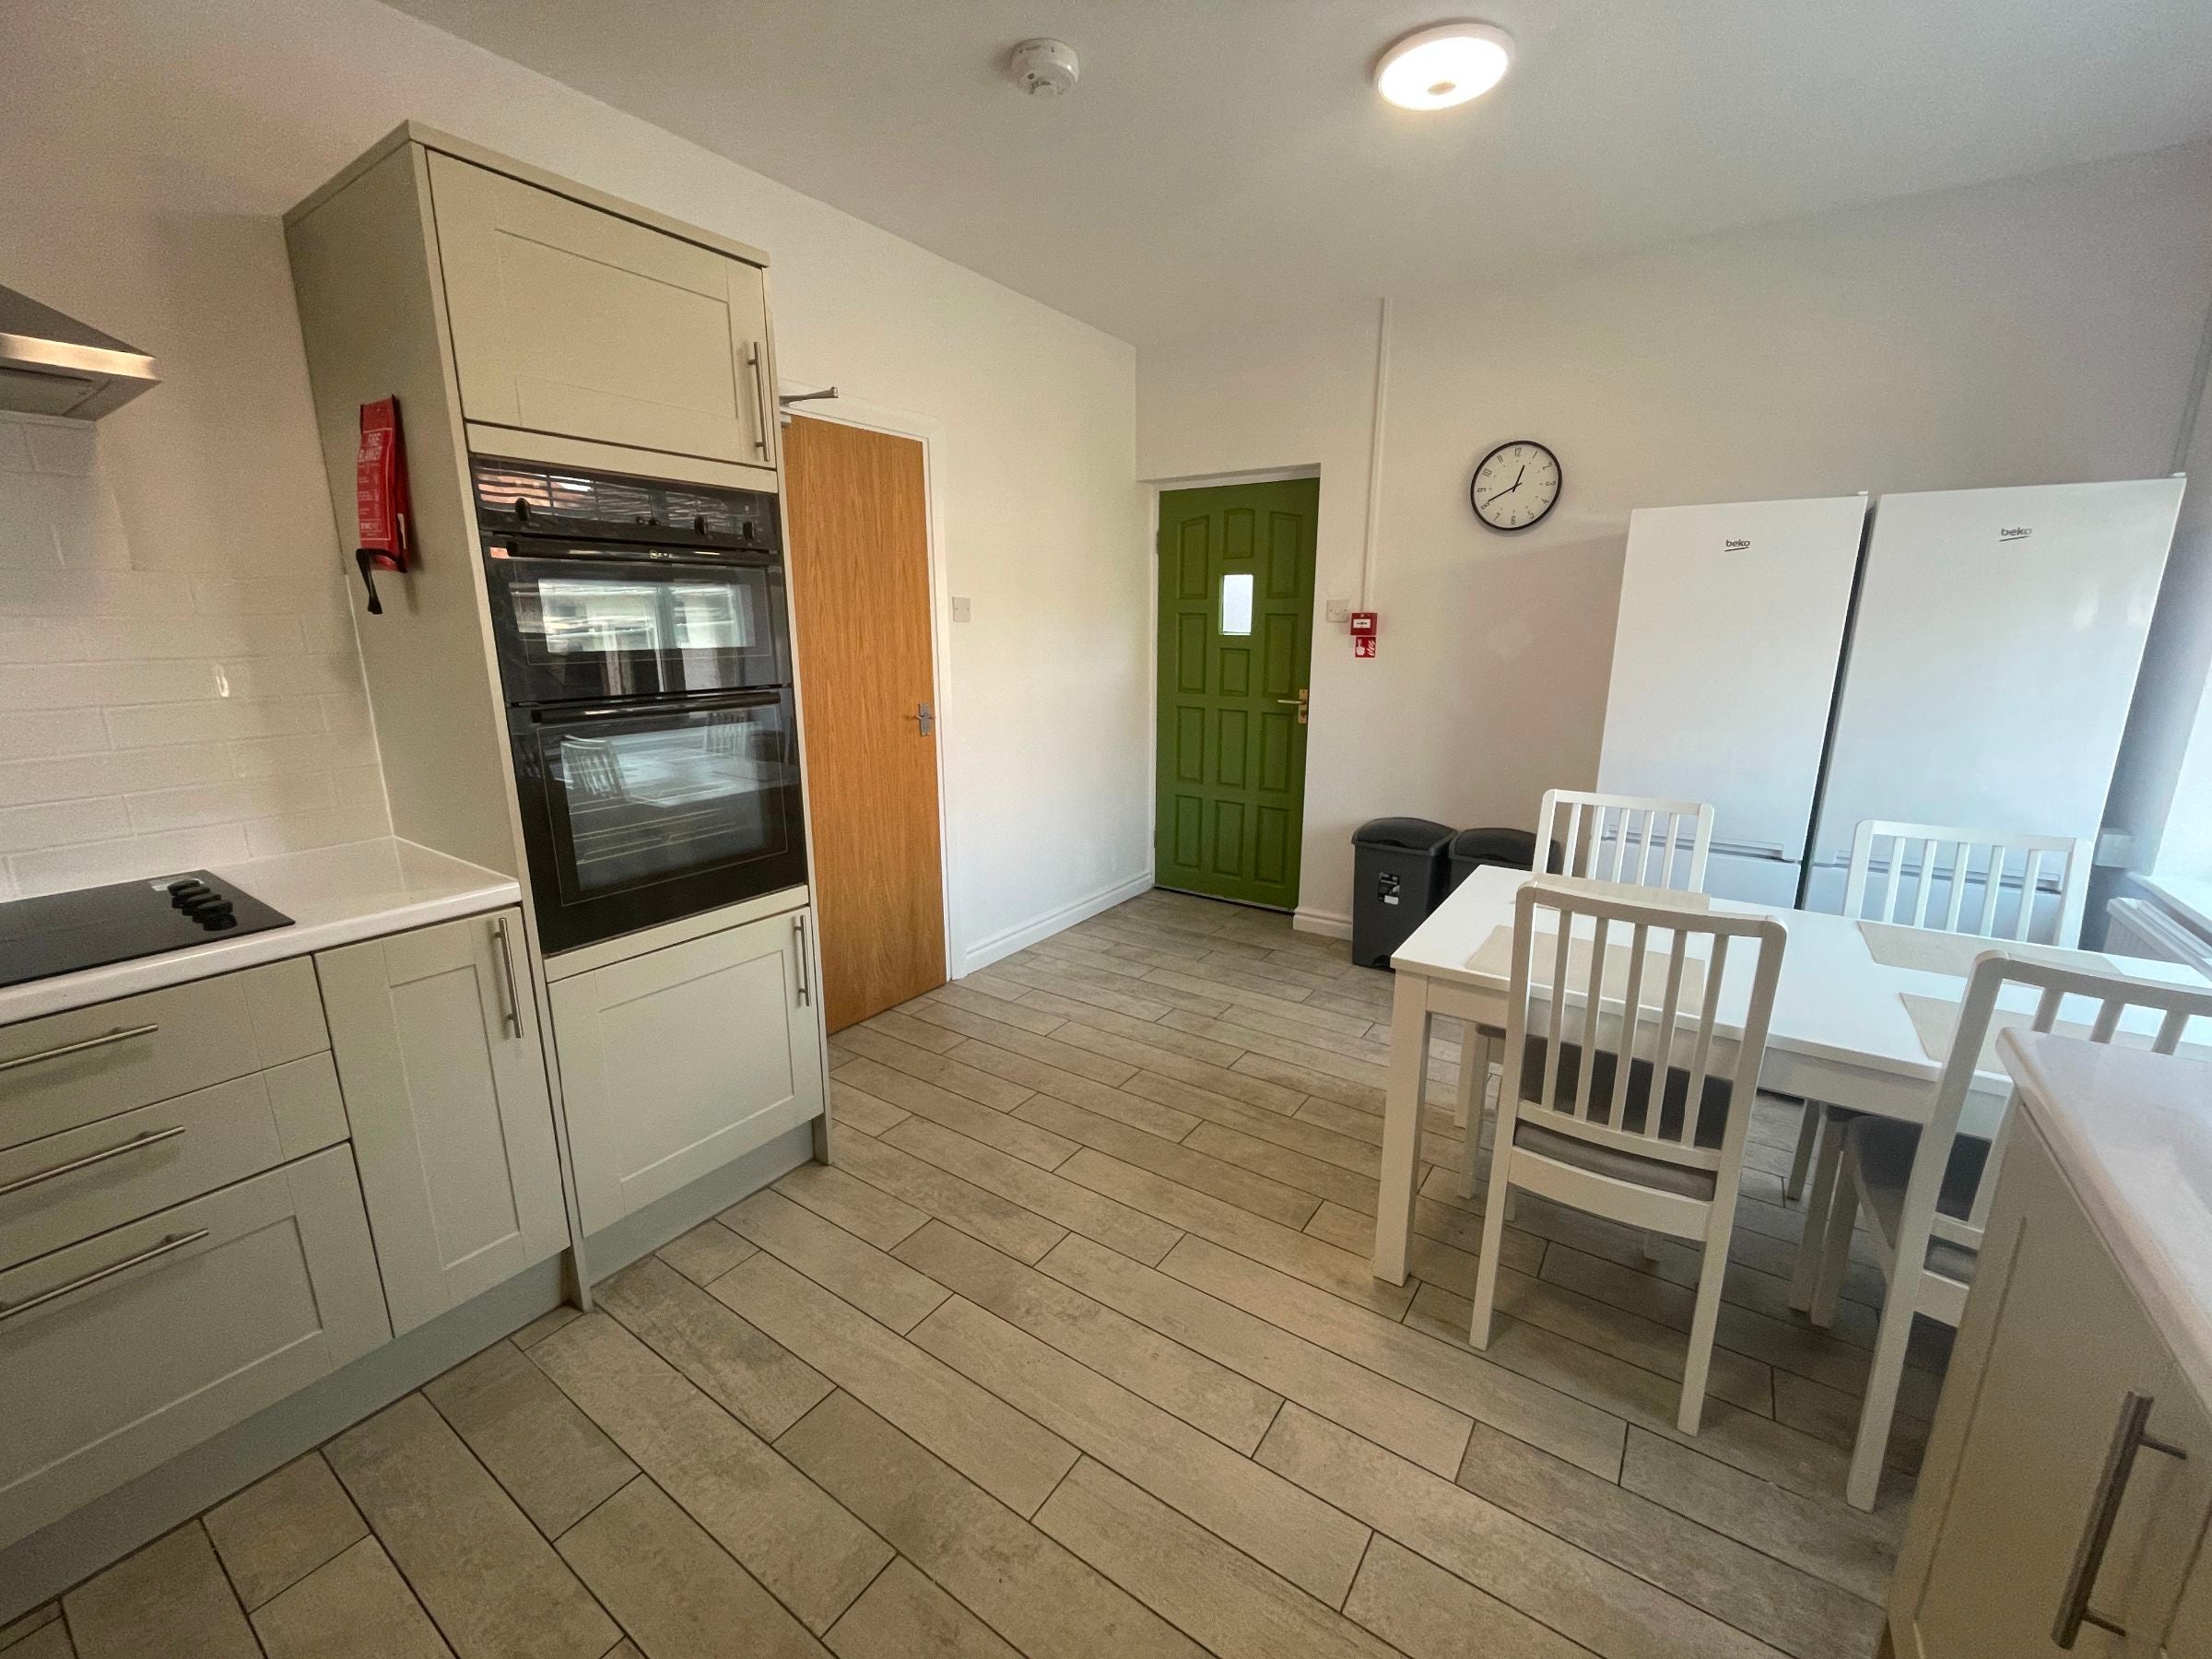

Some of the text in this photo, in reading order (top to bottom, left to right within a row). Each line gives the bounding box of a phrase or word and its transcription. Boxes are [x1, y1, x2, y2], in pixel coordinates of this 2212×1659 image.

[1514, 447, 1522, 457] 12
[1497, 454, 1503, 464] 11
[1542, 462, 1552, 471] 2
[1482, 467, 1492, 477] 10
[1480, 501, 1490, 510] 8
[1493, 512, 1500, 522] 7
[1511, 515, 1516, 525] 6
[1527, 511, 1535, 520] 5
[2001, 527, 2032, 536] beko
[1725, 539, 1750, 547] beko
